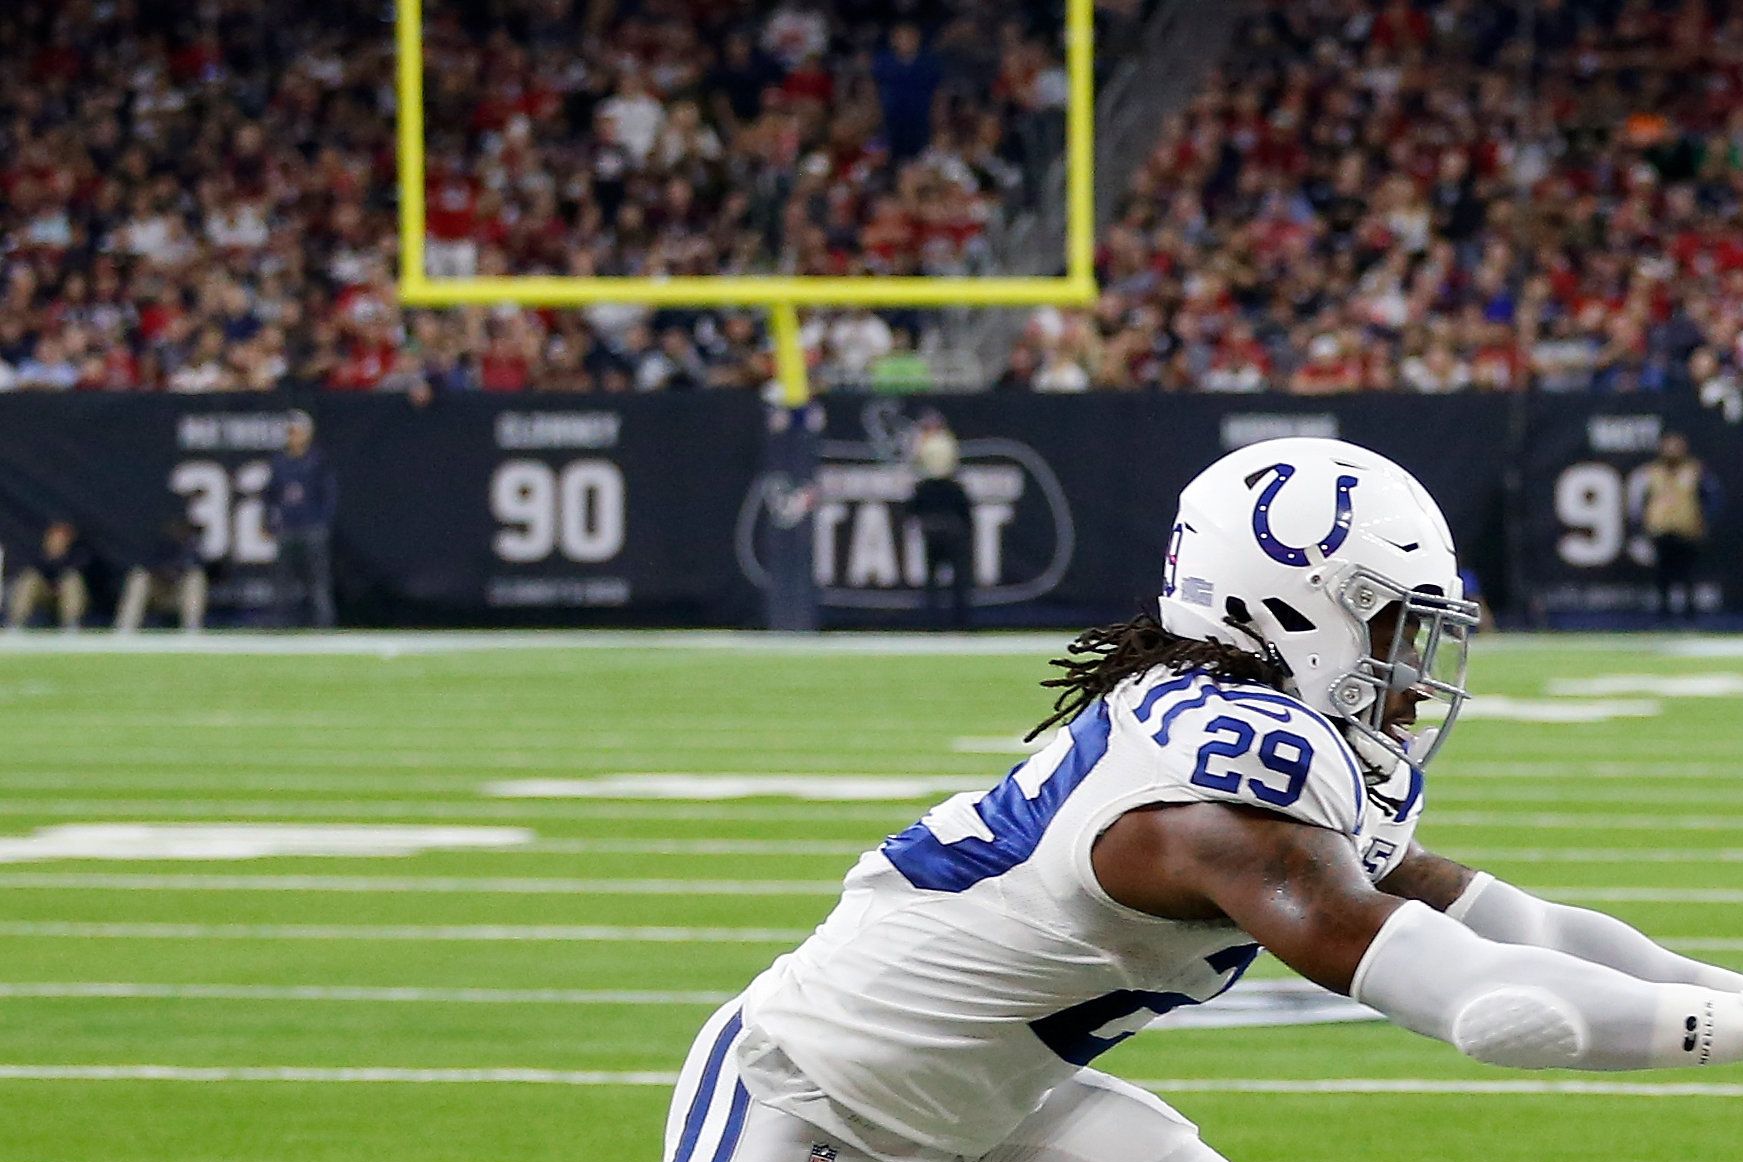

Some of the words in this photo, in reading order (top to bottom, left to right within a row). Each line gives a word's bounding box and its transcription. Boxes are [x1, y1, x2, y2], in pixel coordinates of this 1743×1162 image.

[489, 458, 626, 563] 90
[1191, 715, 1314, 806] 29
[1362, 837, 1398, 883] 5
